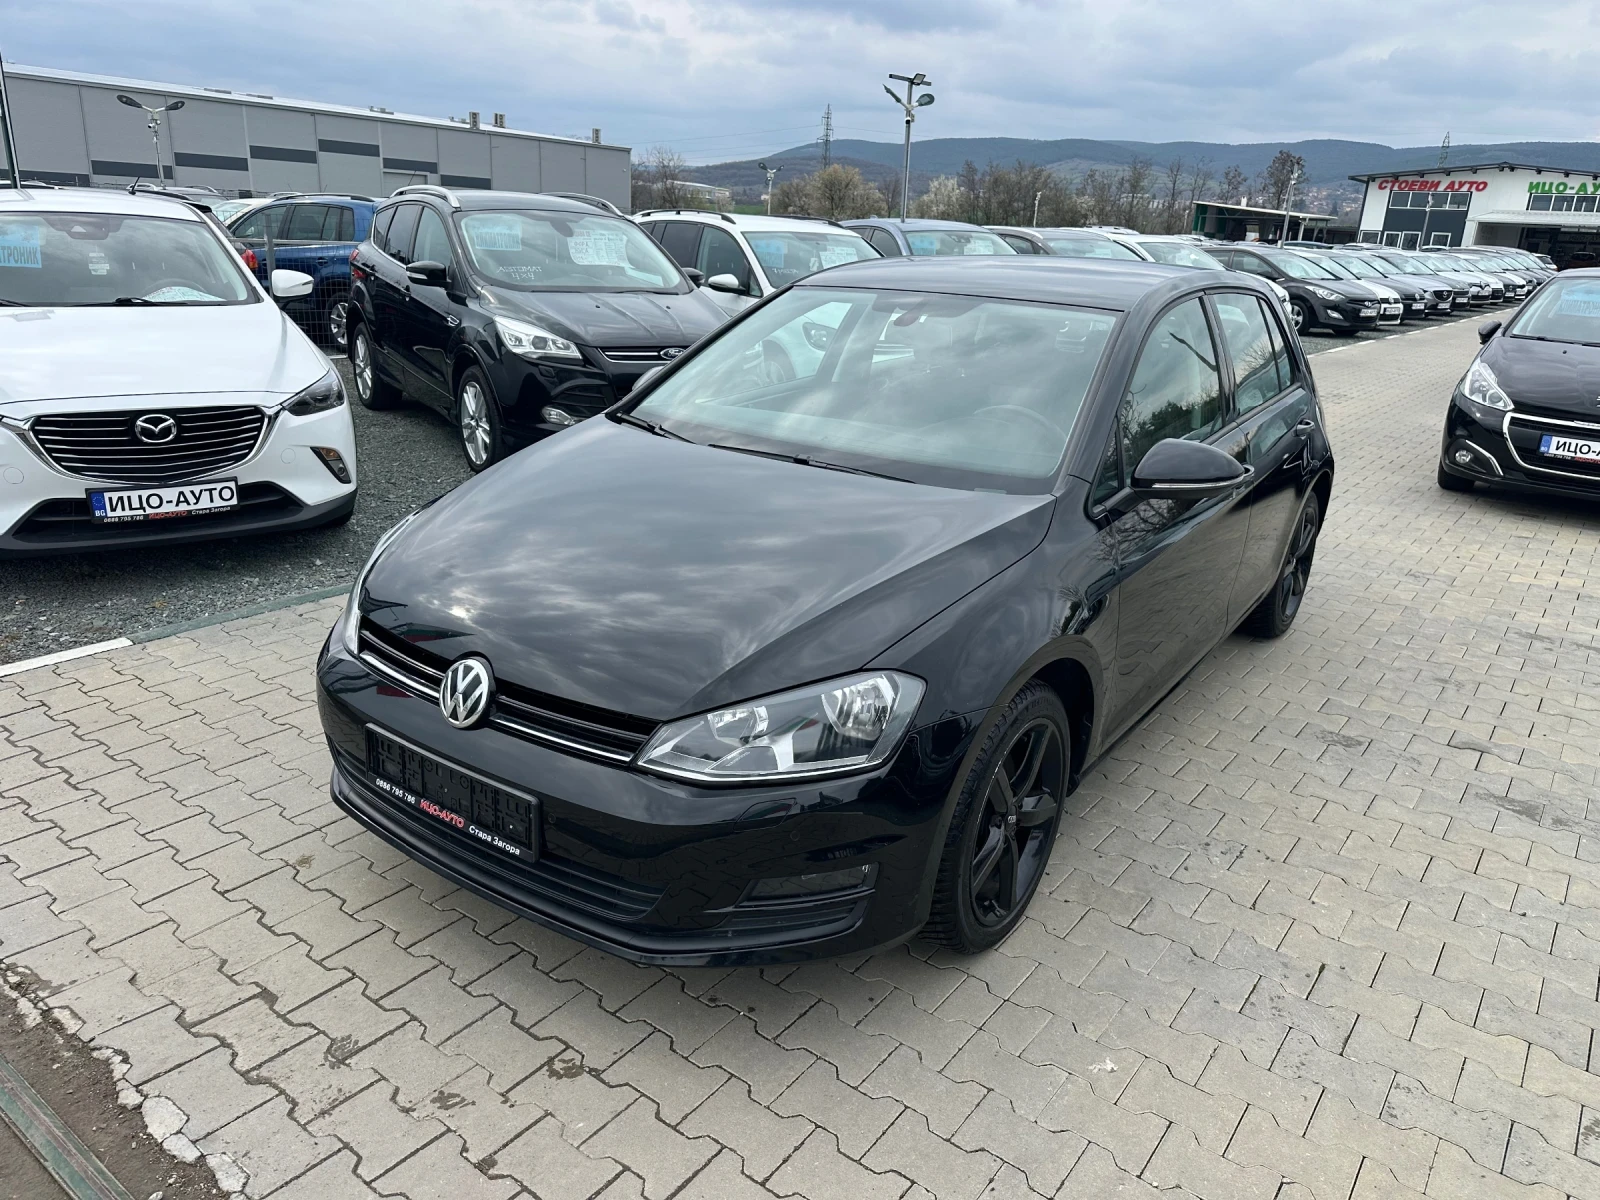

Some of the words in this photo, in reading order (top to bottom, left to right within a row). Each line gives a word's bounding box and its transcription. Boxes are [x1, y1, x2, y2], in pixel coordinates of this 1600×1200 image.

[1377, 179, 1441, 191] СТОЕВИ
[1444, 180, 1488, 192] АУТО
[0, 245, 39, 265] ТРОНИК
[107, 485, 235, 513] ИЦО-АУТО
[95, 509, 106, 517] BG
[148, 510, 187, 519] ИЦО-АУТО
[391, 786, 404, 797] 795
[419, 799, 465, 828] ИЦО-АУТО
[468, 825, 492, 843] Стара
[492, 836, 520, 855] Загора
